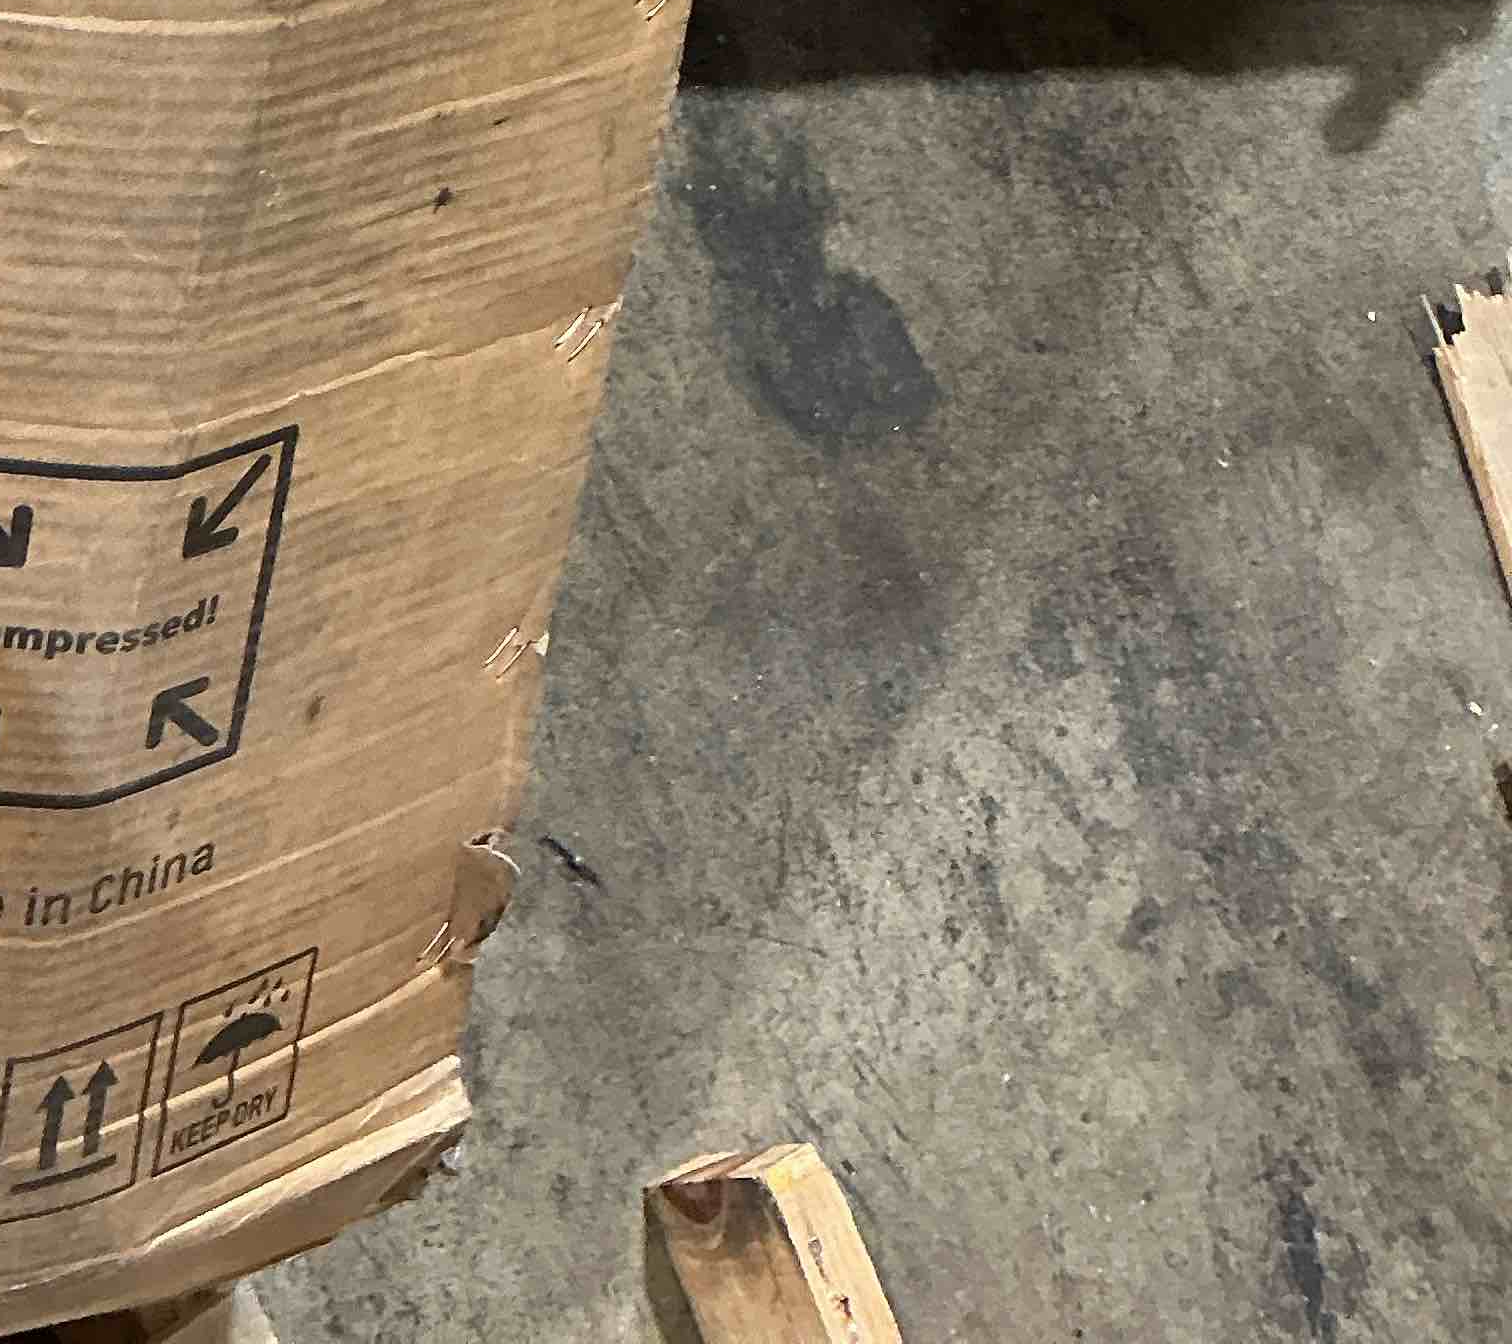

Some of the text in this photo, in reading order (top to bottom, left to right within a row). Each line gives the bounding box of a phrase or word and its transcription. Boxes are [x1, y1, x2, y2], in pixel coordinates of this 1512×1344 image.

[22, 886, 72, 927] in
[88, 840, 217, 916] China
[170, 1084, 278, 1155] KEEP DRY
